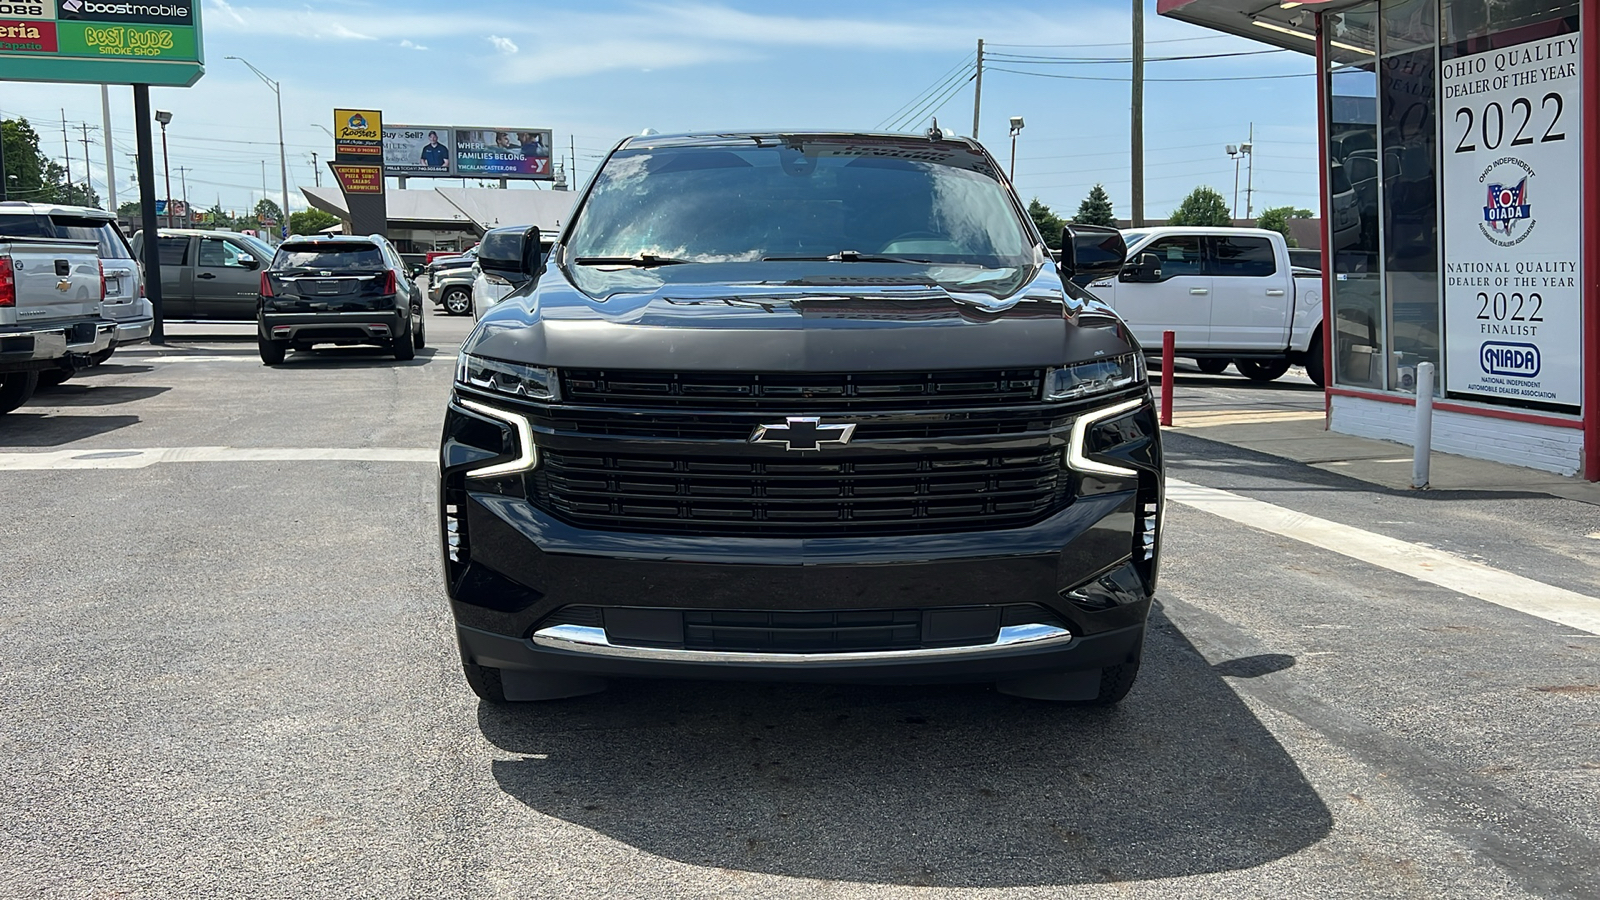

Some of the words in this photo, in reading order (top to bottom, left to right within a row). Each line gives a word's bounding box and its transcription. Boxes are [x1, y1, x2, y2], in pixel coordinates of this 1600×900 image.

[84, 1, 188, 17] boostmobile
[0, 22, 41, 39] eria
[127, 28, 173, 48] BUDZ
[99, 46, 132, 55] SMOKE
[134, 48, 160, 56] SHOP
[1443, 57, 1487, 80] OHIO
[1494, 37, 1579, 72] QUALITY
[1445, 78, 1490, 99] DEALER
[1492, 75, 1509, 90] OF
[1512, 69, 1538, 88] THE
[1540, 62, 1576, 82] YEAR
[1454, 91, 1566, 154] 2022
[404, 131, 424, 140] Sell?
[457, 141, 485, 150] WHERE
[457, 151, 494, 160] FAMILIES
[494, 153, 527, 161] BELONG.
[1478, 164, 1493, 183] OHIO
[1492, 156, 1536, 178] INDEPENDENT
[1489, 206, 1523, 220] OIADA
[1447, 262, 1510, 273] NATIONAL
[1515, 262, 1577, 274] QUALITY
[1448, 277, 1490, 287] DEALER
[1495, 277, 1509, 287] OF
[1514, 277, 1537, 287] THE
[1542, 277, 1575, 287] YEAR
[1476, 292, 1544, 322] 2022
[1480, 323, 1538, 336] FINALIST
[1484, 348, 1535, 371] NIADA
[1481, 376, 1506, 385] NATIONAL
[1505, 379, 1541, 389] INDEPENDENT
[1467, 383, 1498, 393] AUTOMOBILE
[1498, 386, 1520, 395] DEALERS
[1520, 389, 1557, 399] ASSOCIATION
